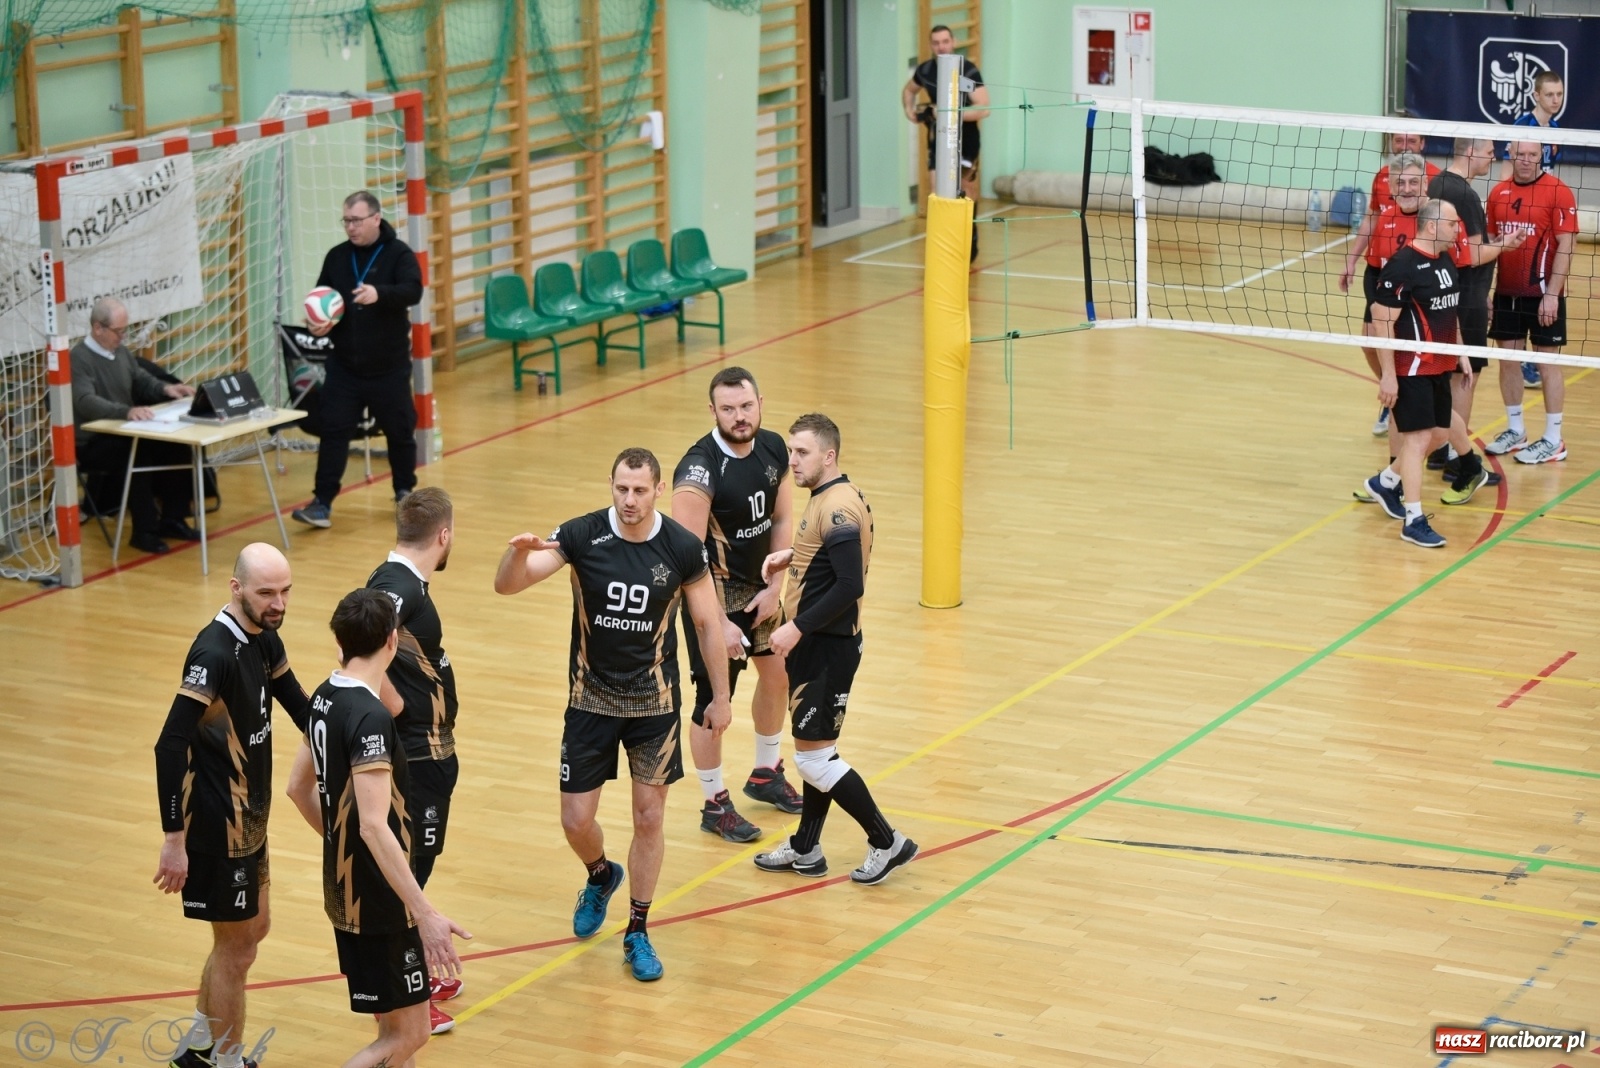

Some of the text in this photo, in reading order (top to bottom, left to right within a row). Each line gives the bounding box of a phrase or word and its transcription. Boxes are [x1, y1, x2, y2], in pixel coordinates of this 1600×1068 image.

[1511, 197, 1522, 215] 4
[1434, 268, 1453, 289] 10
[748, 490, 766, 522] 10
[606, 581, 650, 615] 99
[594, 614, 653, 633] AGROTIM
[361, 734, 380, 744] DARK
[365, 741, 381, 750] SIDE
[363, 748, 380, 757] CARS
[560, 763, 570, 782] 9
[424, 827, 436, 846] 5
[234, 890, 247, 910] 4
[403, 970, 424, 994] 19
